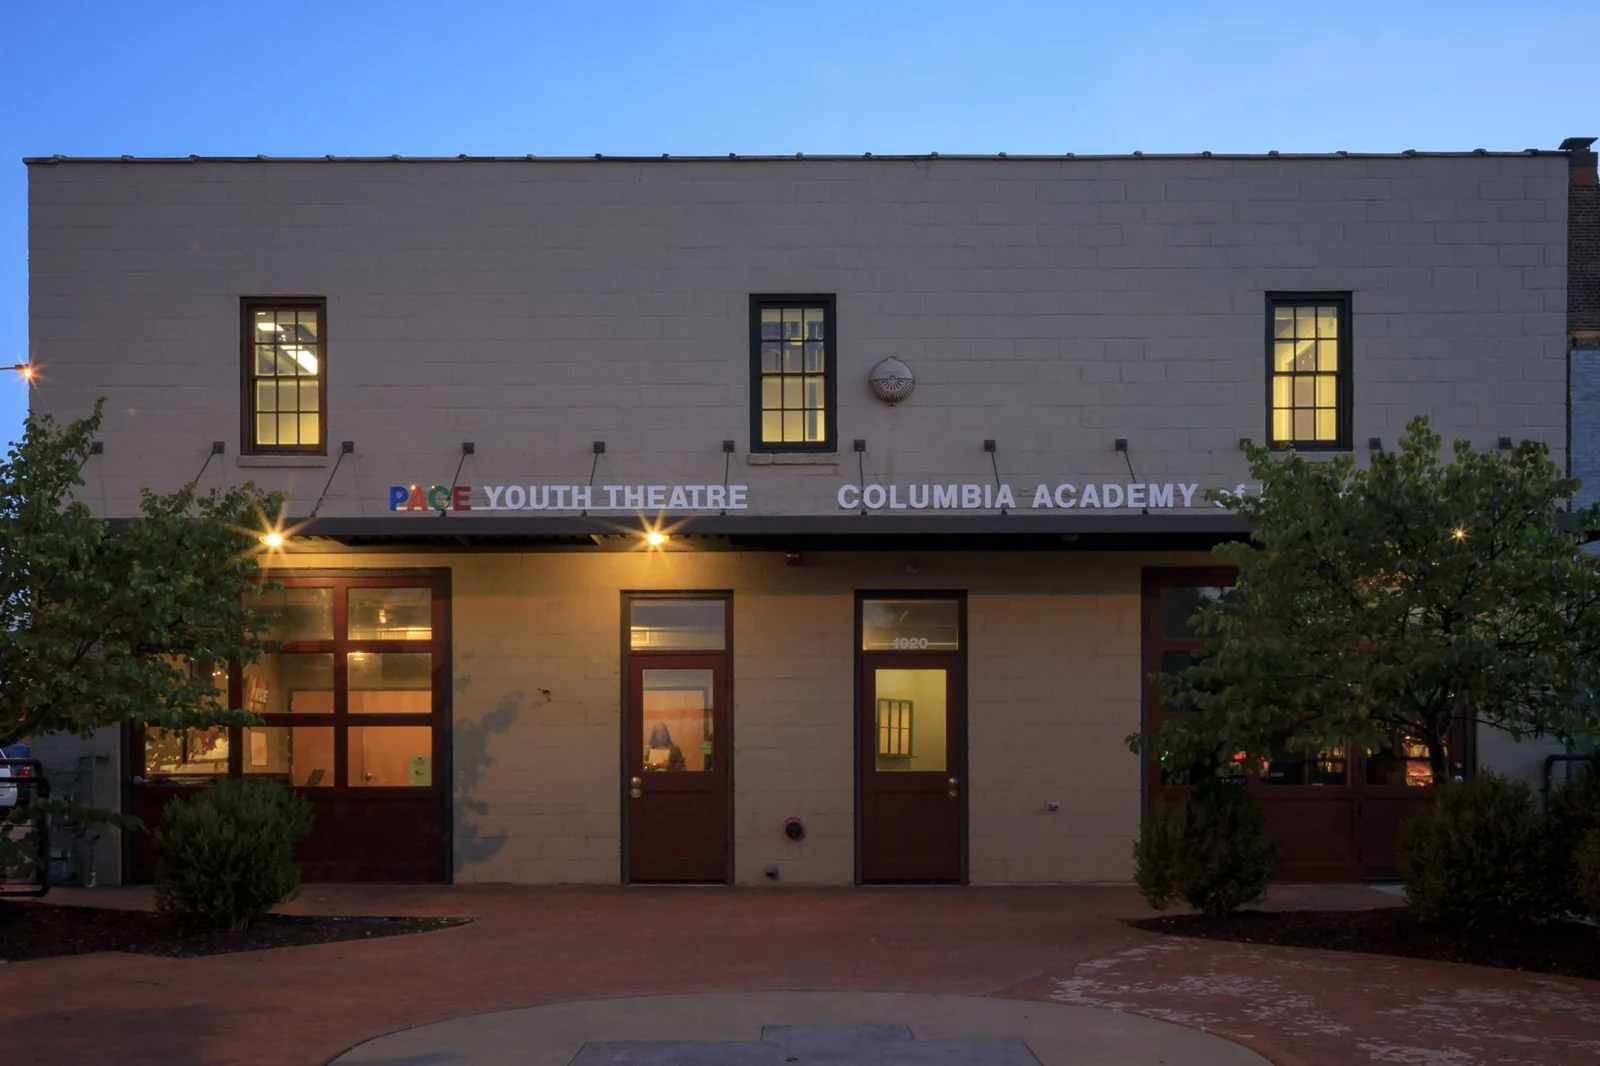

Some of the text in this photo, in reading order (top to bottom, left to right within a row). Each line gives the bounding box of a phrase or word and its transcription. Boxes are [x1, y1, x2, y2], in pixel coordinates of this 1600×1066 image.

[390, 485, 748, 511] PACE YOUTH THEATRE
[837, 484, 1015, 509] COLUMBIA
[1032, 484, 1199, 508] ACADEMY
